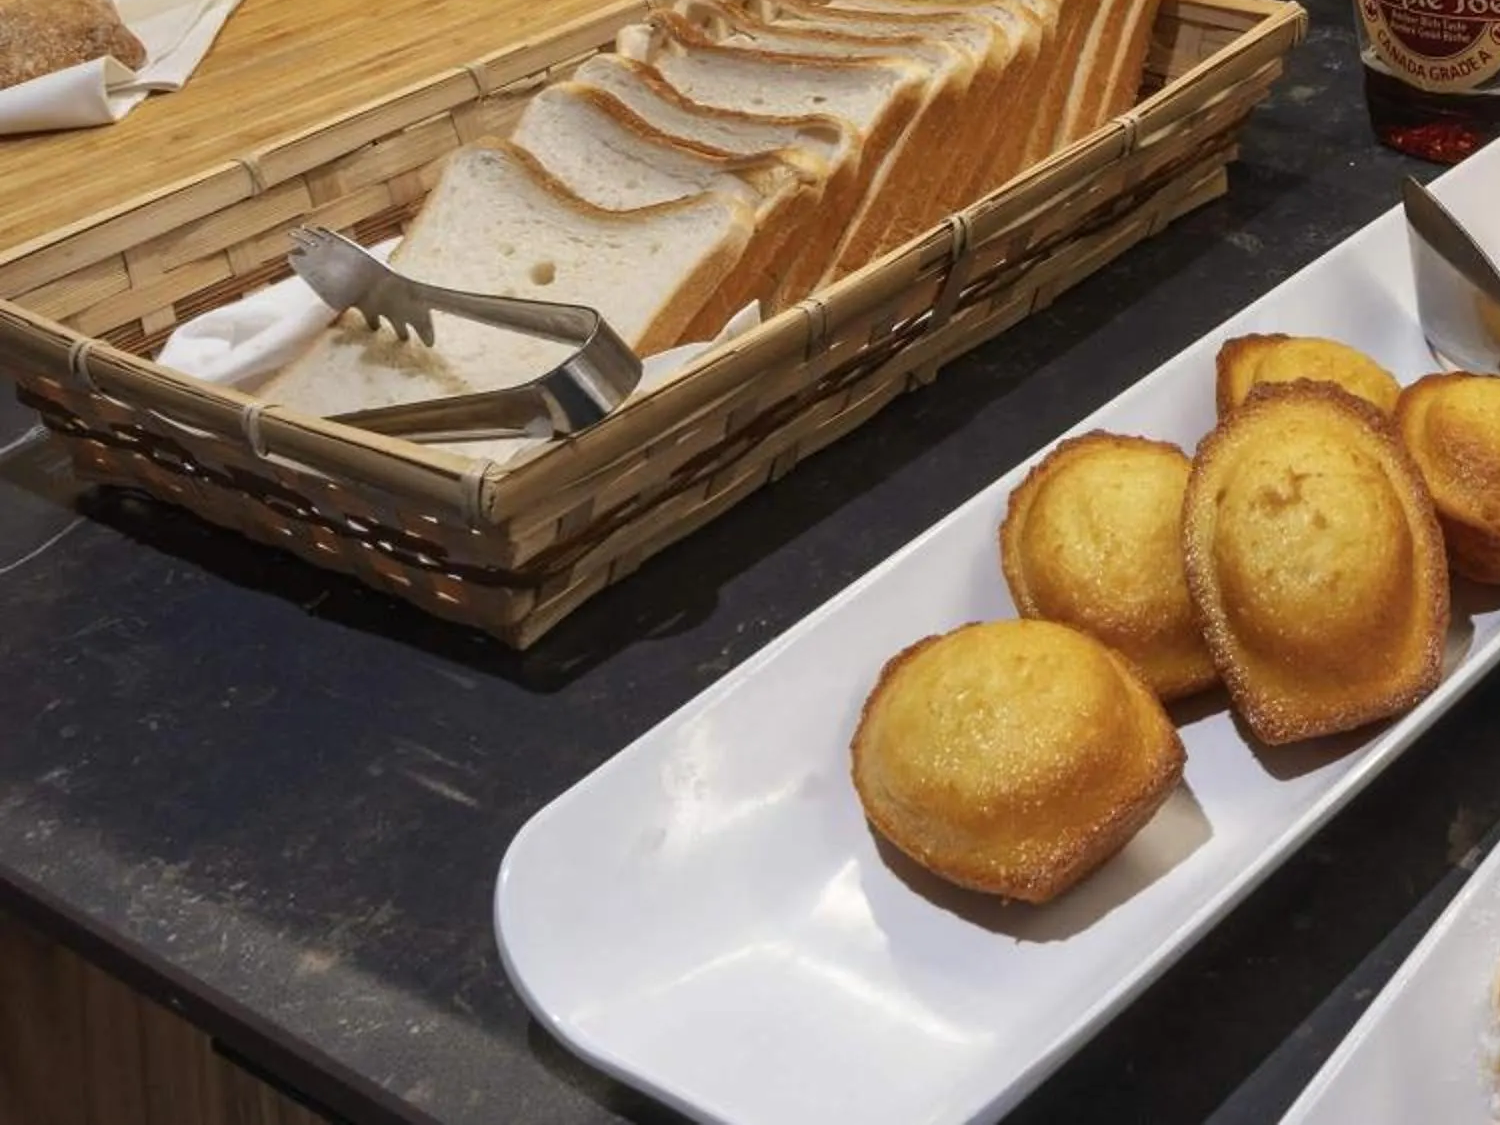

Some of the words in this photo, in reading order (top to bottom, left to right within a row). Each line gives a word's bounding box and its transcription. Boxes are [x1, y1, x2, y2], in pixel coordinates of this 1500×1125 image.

[1377, 29, 1425, 77] CANADA
[1429, 57, 1480, 82] GRADE
[1480, 50, 1493, 66] A
